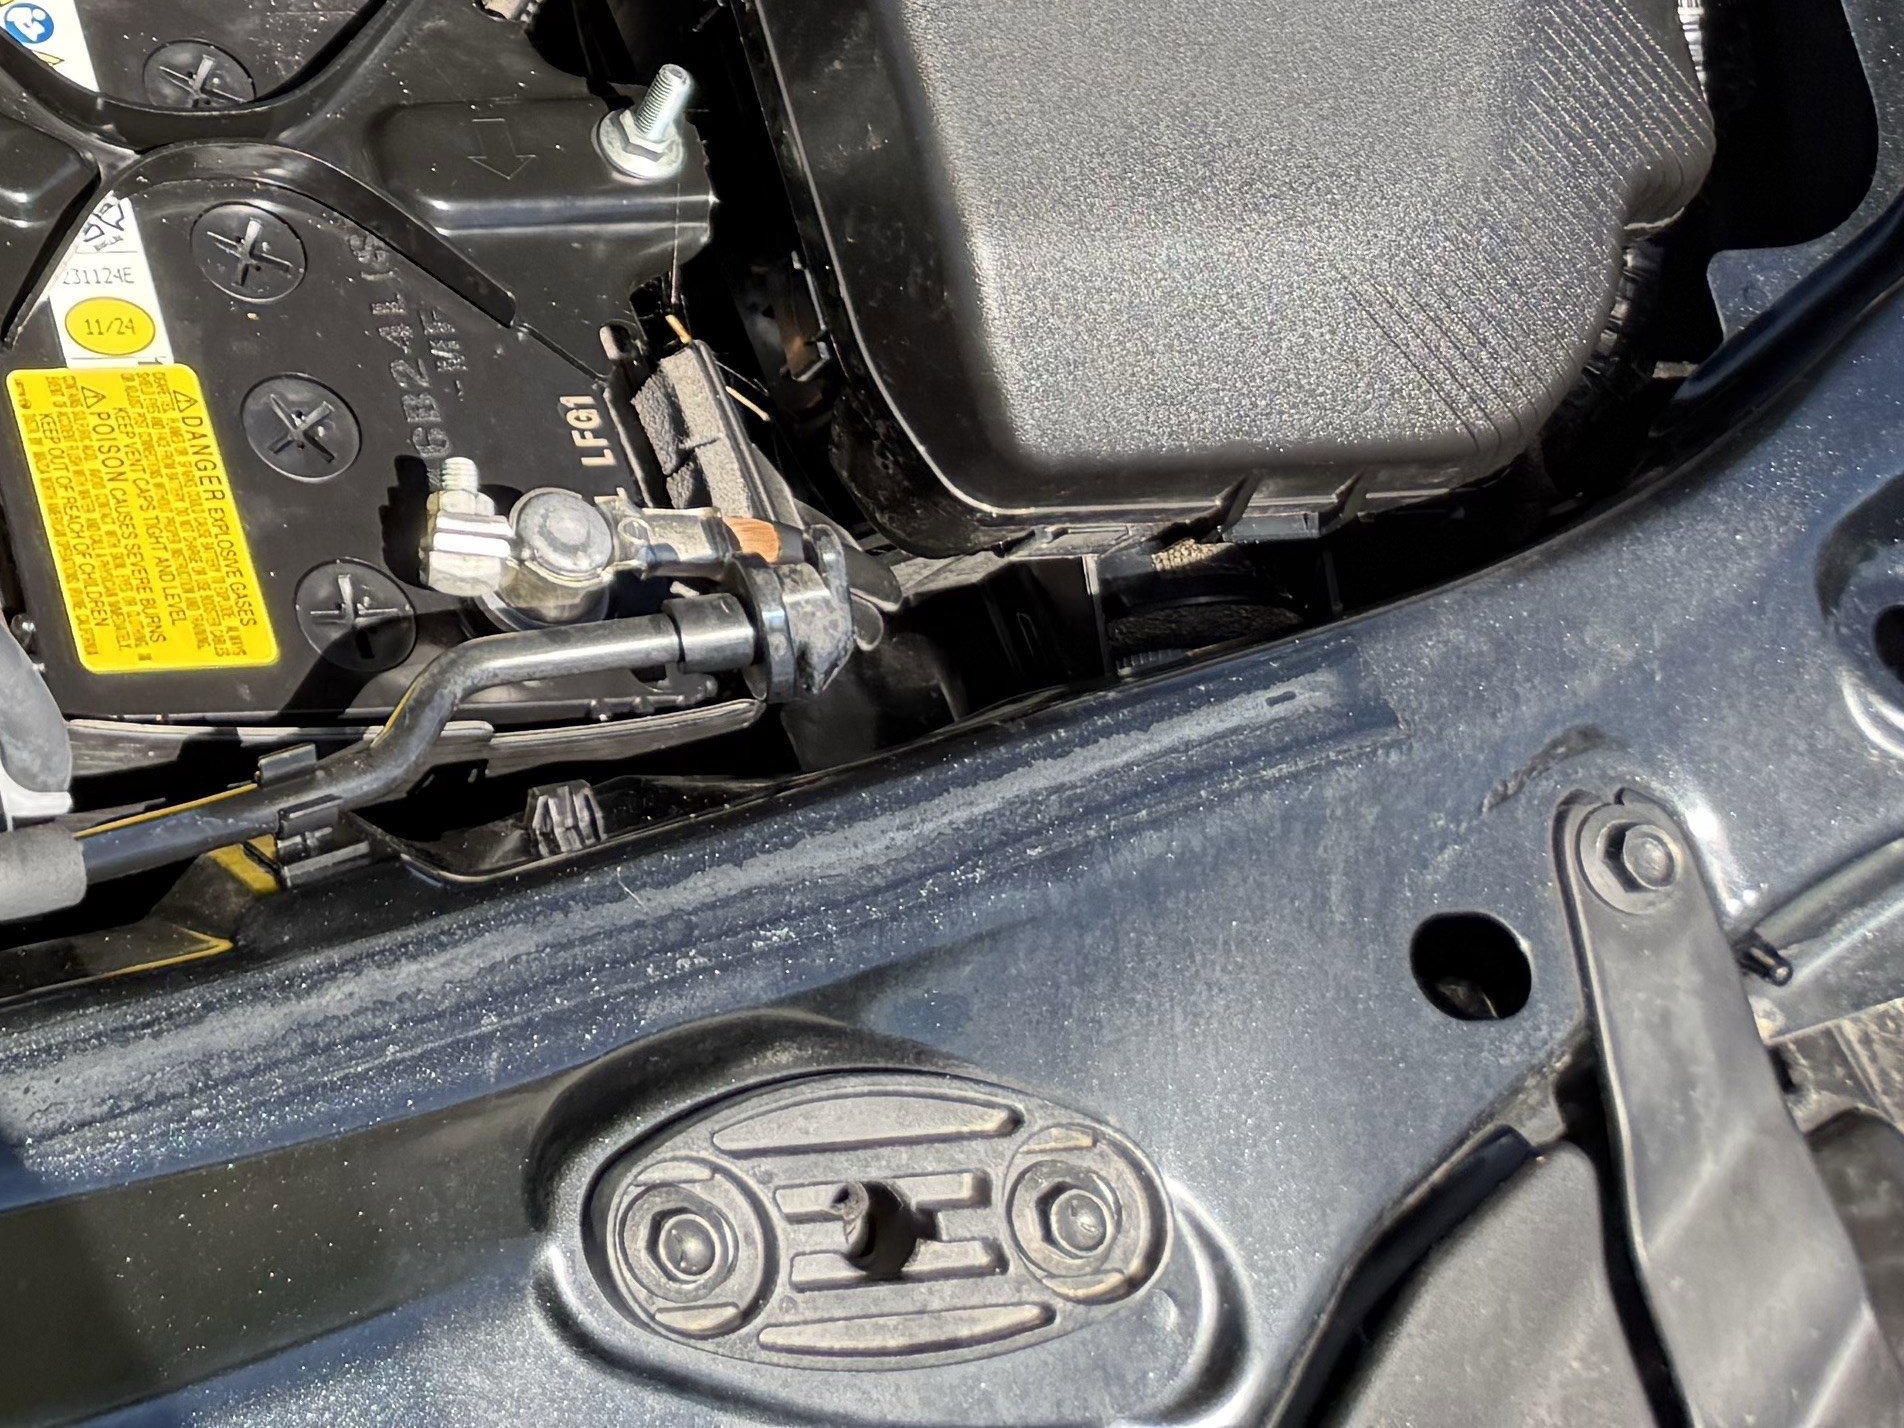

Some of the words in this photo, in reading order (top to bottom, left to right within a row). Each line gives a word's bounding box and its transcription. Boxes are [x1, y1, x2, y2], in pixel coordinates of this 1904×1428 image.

[84, 317, 136, 336] 11/24
[40, 413, 61, 444] KEEP
[114, 407, 136, 439] KEEP
[562, 395, 616, 468] LFG1
[46, 447, 69, 472] OUT
[89, 411, 128, 482] POISON
[123, 442, 147, 474] VENT
[54, 476, 75, 492] OF
[131, 478, 156, 511] CAPS
[62, 496, 84, 539] REACH
[108, 487, 138, 540] CAUSES
[180, 416, 226, 501] DANGER
[207, 507, 244, 578] EXPLOSIVE
[228, 582, 258, 627] GASES
[71, 543, 93, 559] OF
[145, 515, 168, 552] TIGHT
[123, 543, 154, 593] SEVERE
[155, 556, 176, 582] AND
[77, 563, 109, 627] CHILDREN
[161, 586, 187, 626] LEVEL
[138, 598, 167, 643] BURNS
